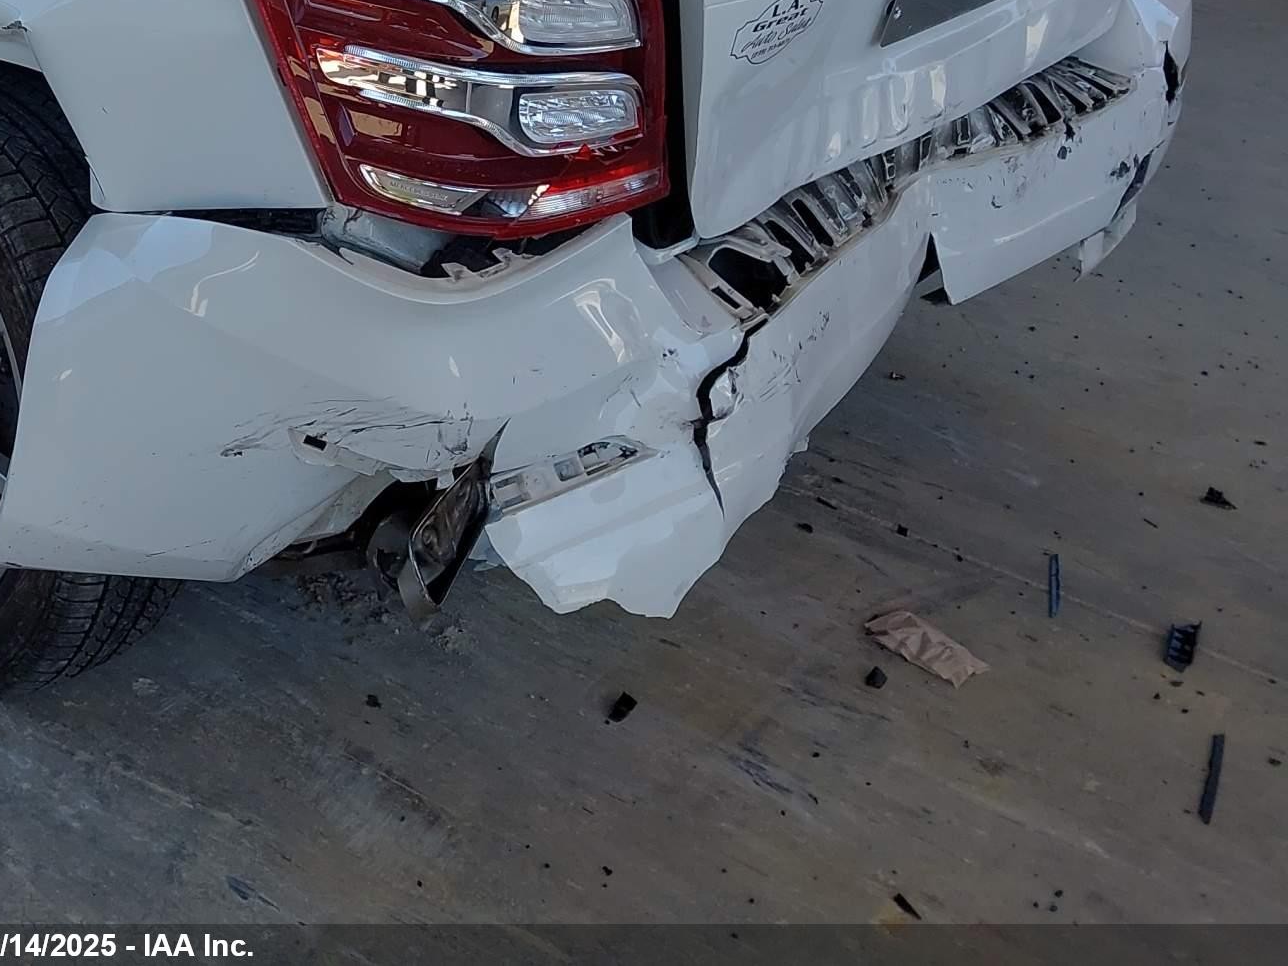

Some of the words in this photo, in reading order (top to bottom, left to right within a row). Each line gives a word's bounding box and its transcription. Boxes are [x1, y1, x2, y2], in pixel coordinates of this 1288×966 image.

[740, 32, 778, 53] Auto
[777, 17, 812, 41] Sales
[752, 7, 809, 33] Great
